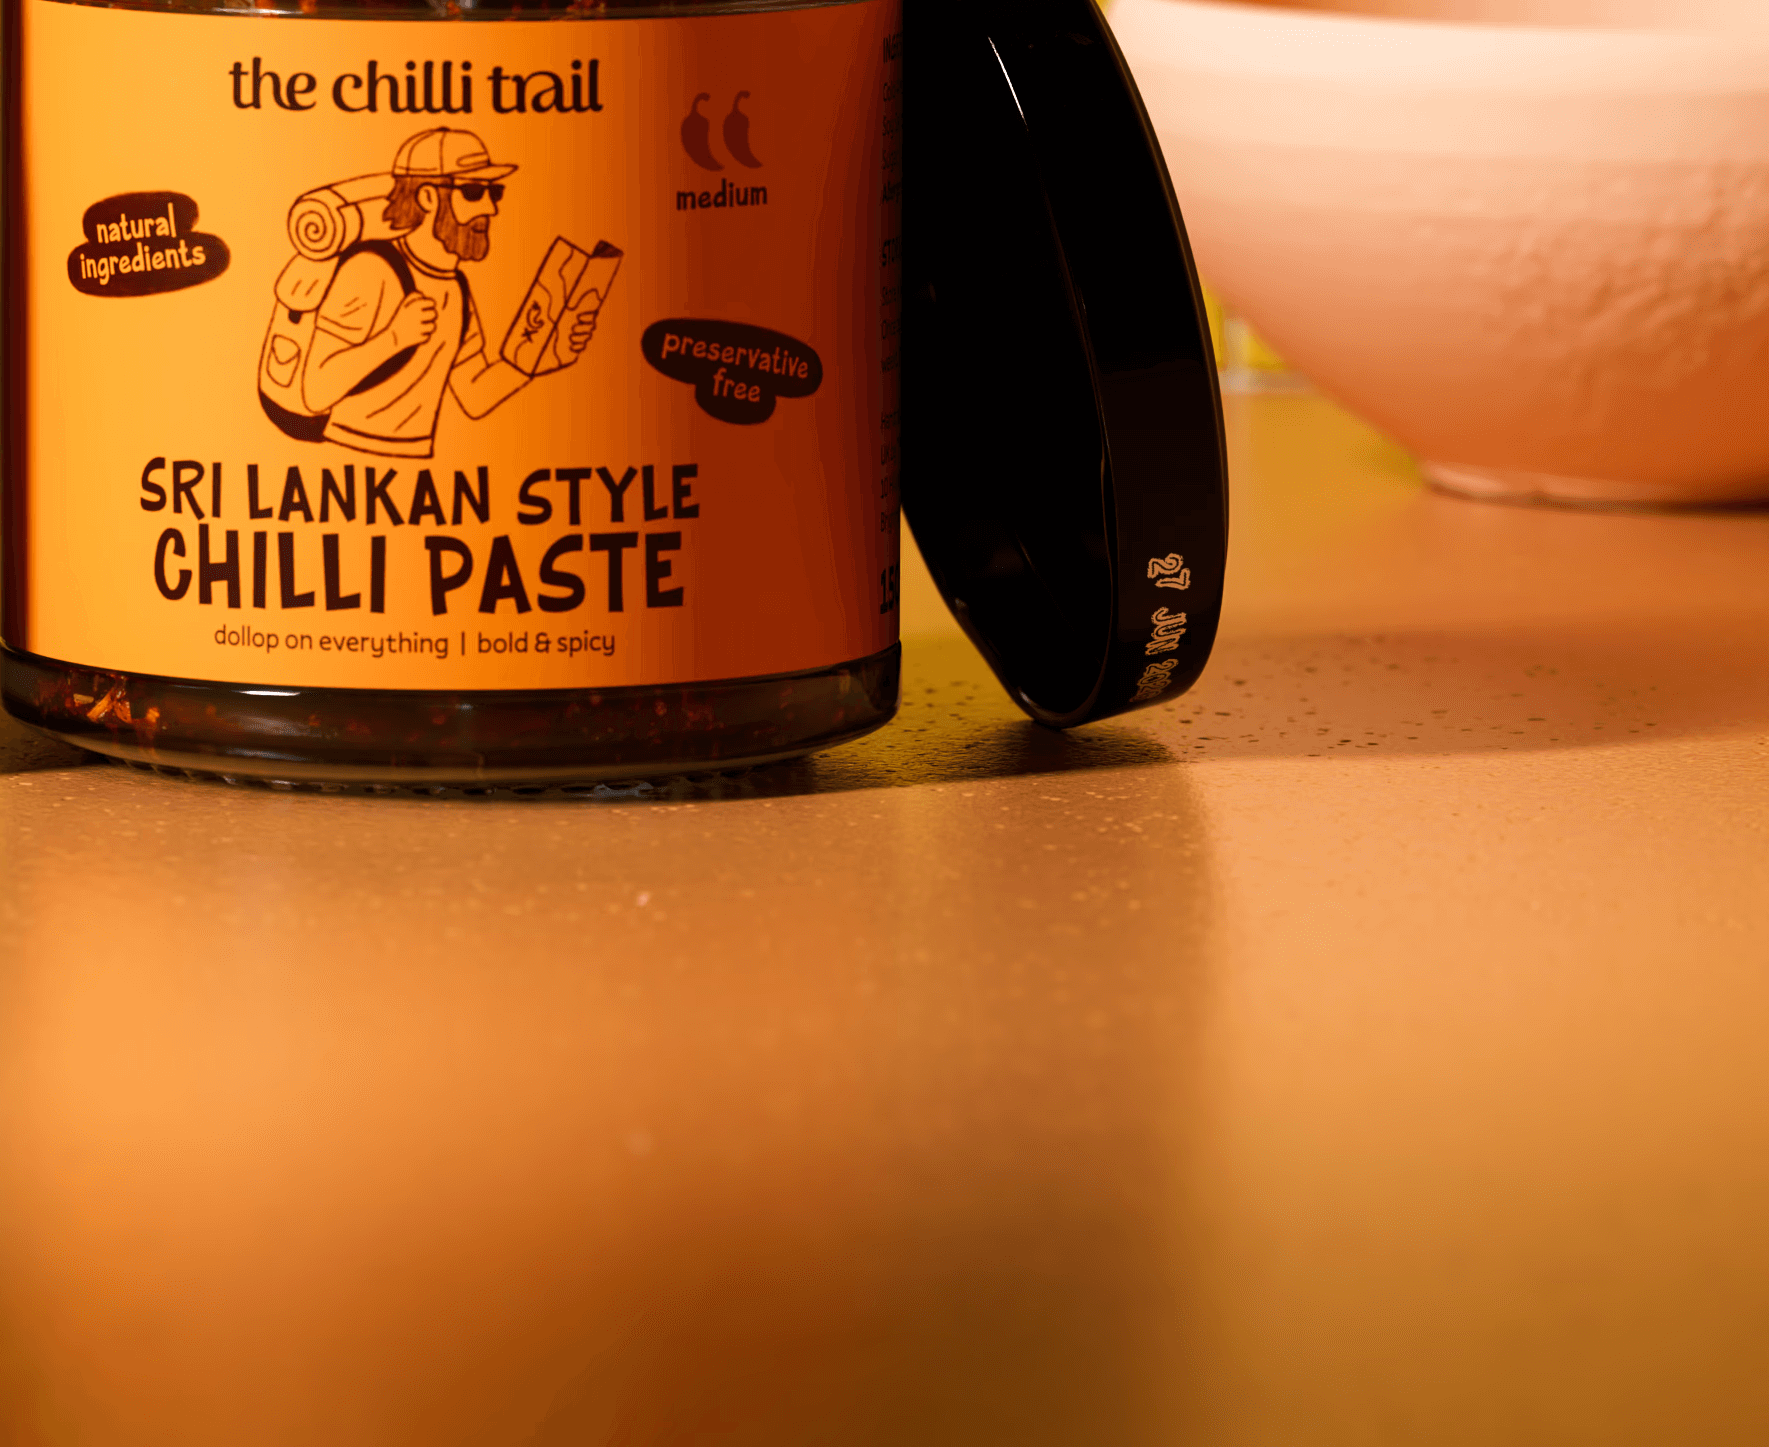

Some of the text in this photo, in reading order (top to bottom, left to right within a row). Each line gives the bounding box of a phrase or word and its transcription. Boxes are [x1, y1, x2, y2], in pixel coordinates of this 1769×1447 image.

[229, 57, 604, 114] the chilli trail
[676, 178, 767, 211] medium
[96, 202, 176, 244] natural
[80, 239, 206, 285] ingredients
[661, 333, 808, 378] preservative
[713, 367, 760, 402] free
[140, 456, 700, 527] SRI LANKAN STYLE
[154, 523, 684, 616] CHILLI PASTE
[1147, 553, 1191, 591] 27
[215, 625, 278, 653] dollop
[286, 635, 312, 649] on
[320, 632, 448, 659] everything
[478, 632, 528, 653] bold
[535, 632, 551, 653] &
[557, 630, 615, 657] spicy
[1144, 606, 1187, 656] JUN
